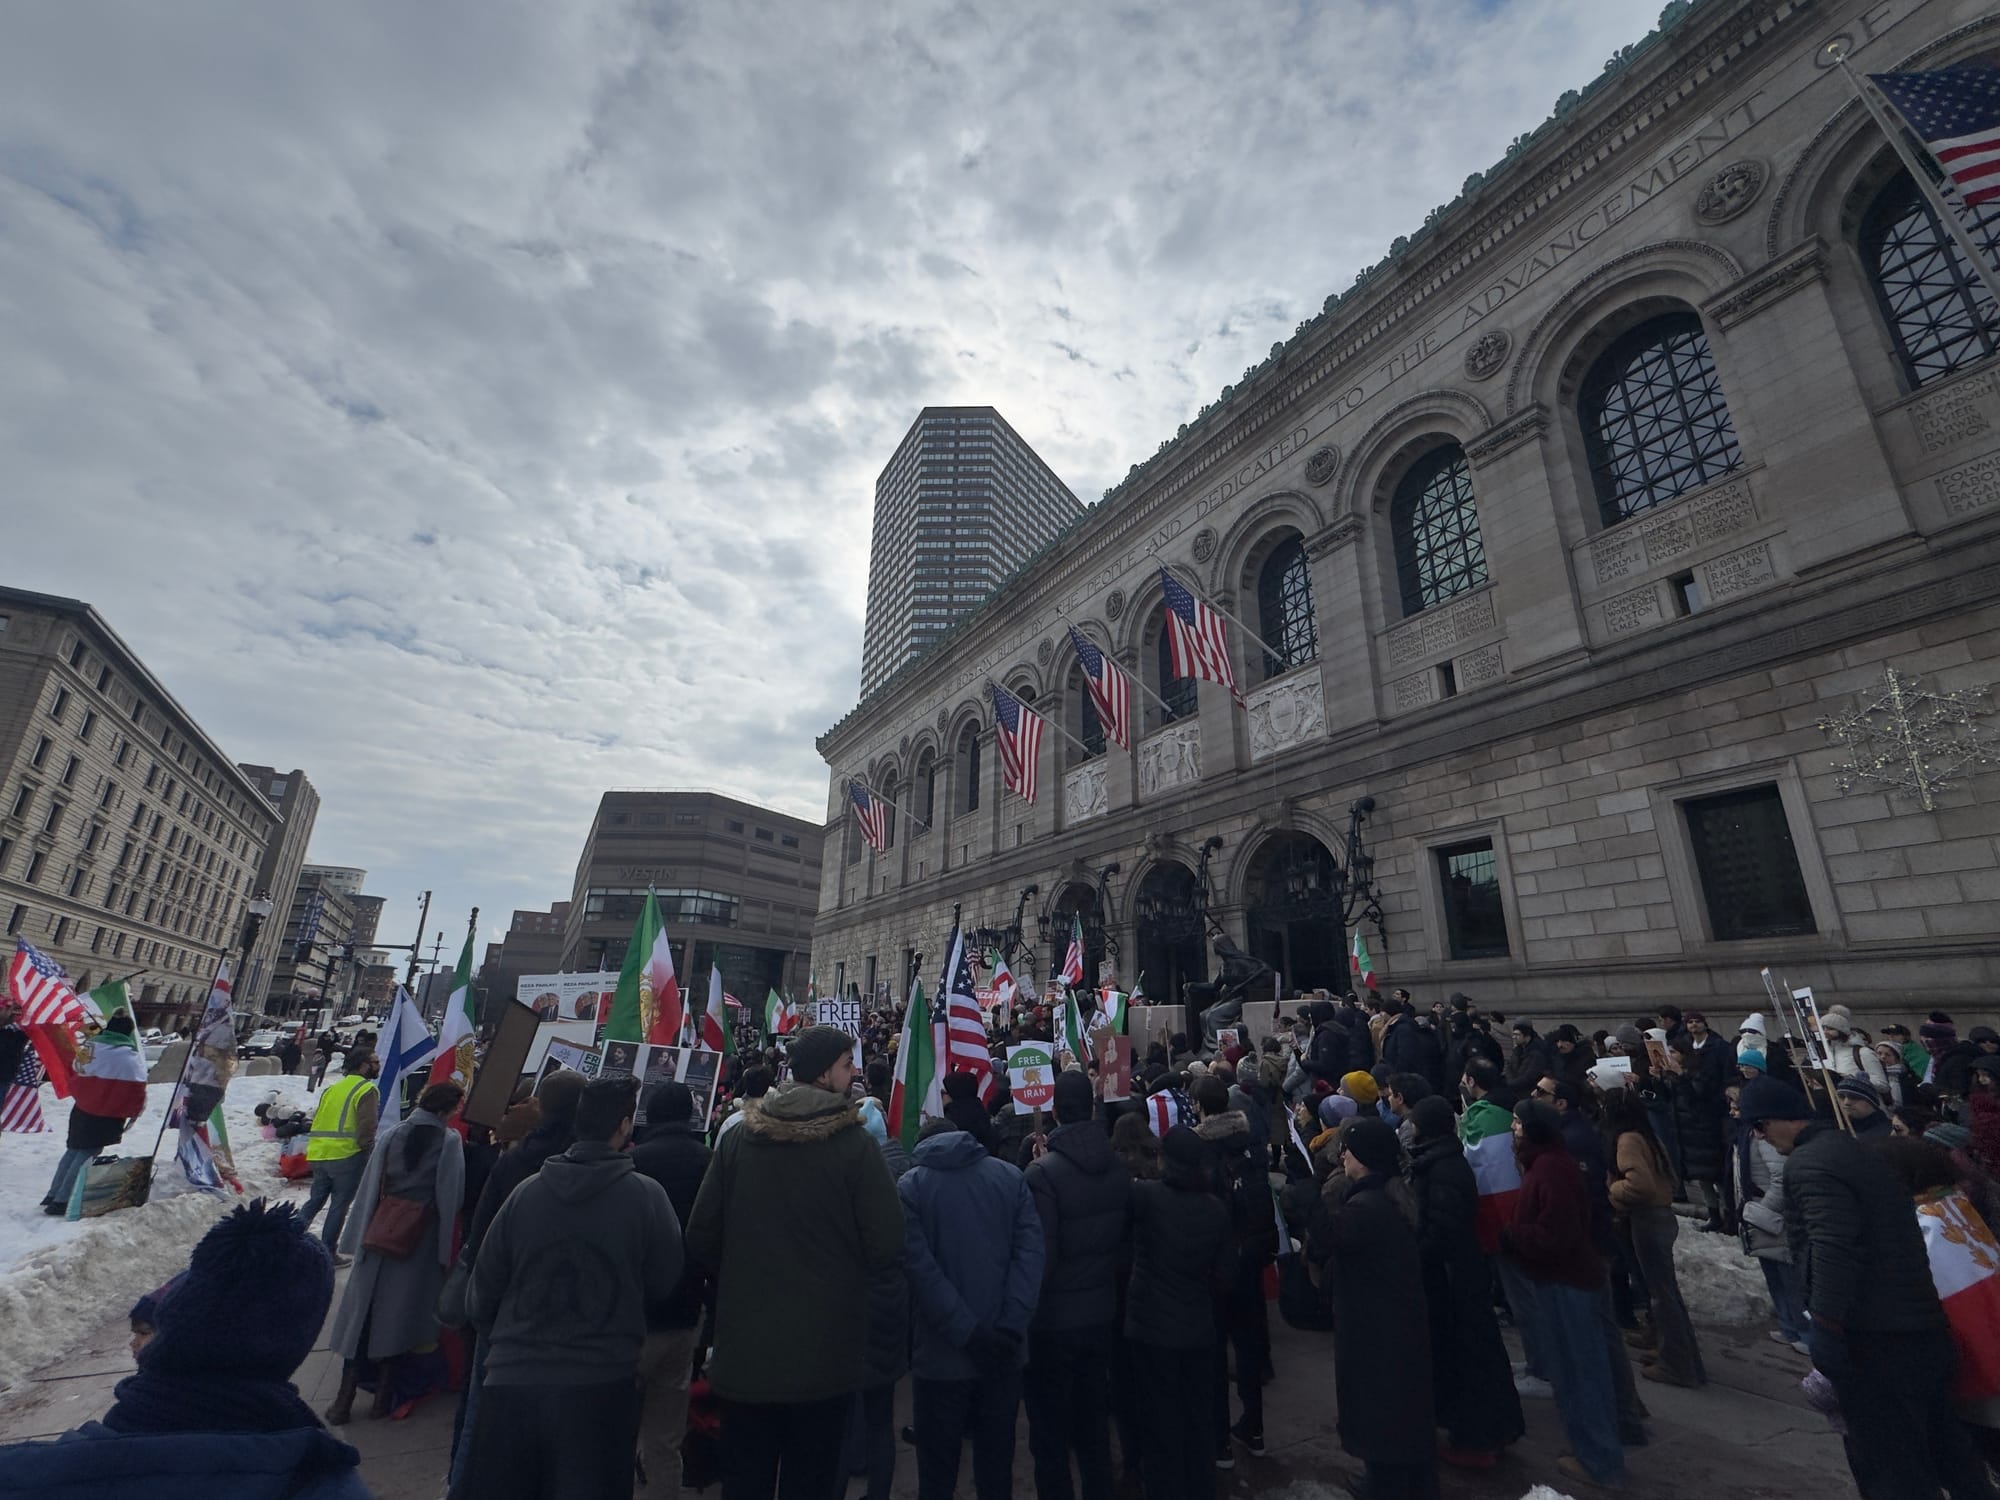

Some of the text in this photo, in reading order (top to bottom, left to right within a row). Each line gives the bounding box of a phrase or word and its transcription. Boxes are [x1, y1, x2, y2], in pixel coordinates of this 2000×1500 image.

[1088, 551, 1136, 596] PEOPLE
[1148, 519, 1181, 551] AND
[1196, 427, 1309, 521] DEDICATED
[1329, 387, 1364, 418] TO
[1381, 331, 1441, 384] THE
[1462, 89, 1766, 329] ADVANCEMENT
[1815, 9, 1890, 69] OF
[1925, 411, 1982, 442] DARWIN
[1692, 485, 1736, 508] ARNOLD
[1644, 510, 1680, 531] SYDNEY
[1697, 498, 1749, 525] CHAPMAN
[1597, 551, 1622, 568] SWIFT
[1599, 553, 1641, 576] CARLYLE
[1711, 557, 1762, 582] RABELAIS
[1600, 567, 1629, 584] LAMB
[1713, 569, 1752, 589] RACINE
[1610, 606, 1654, 627] CAXTON
[618, 865, 675, 881] WESTIN
[819, 1003, 861, 1021] FREE
[818, 1021, 861, 1038] AN
[1017, 1055, 1041, 1066] FREE
[1023, 1087, 1046, 1099] IRAN
